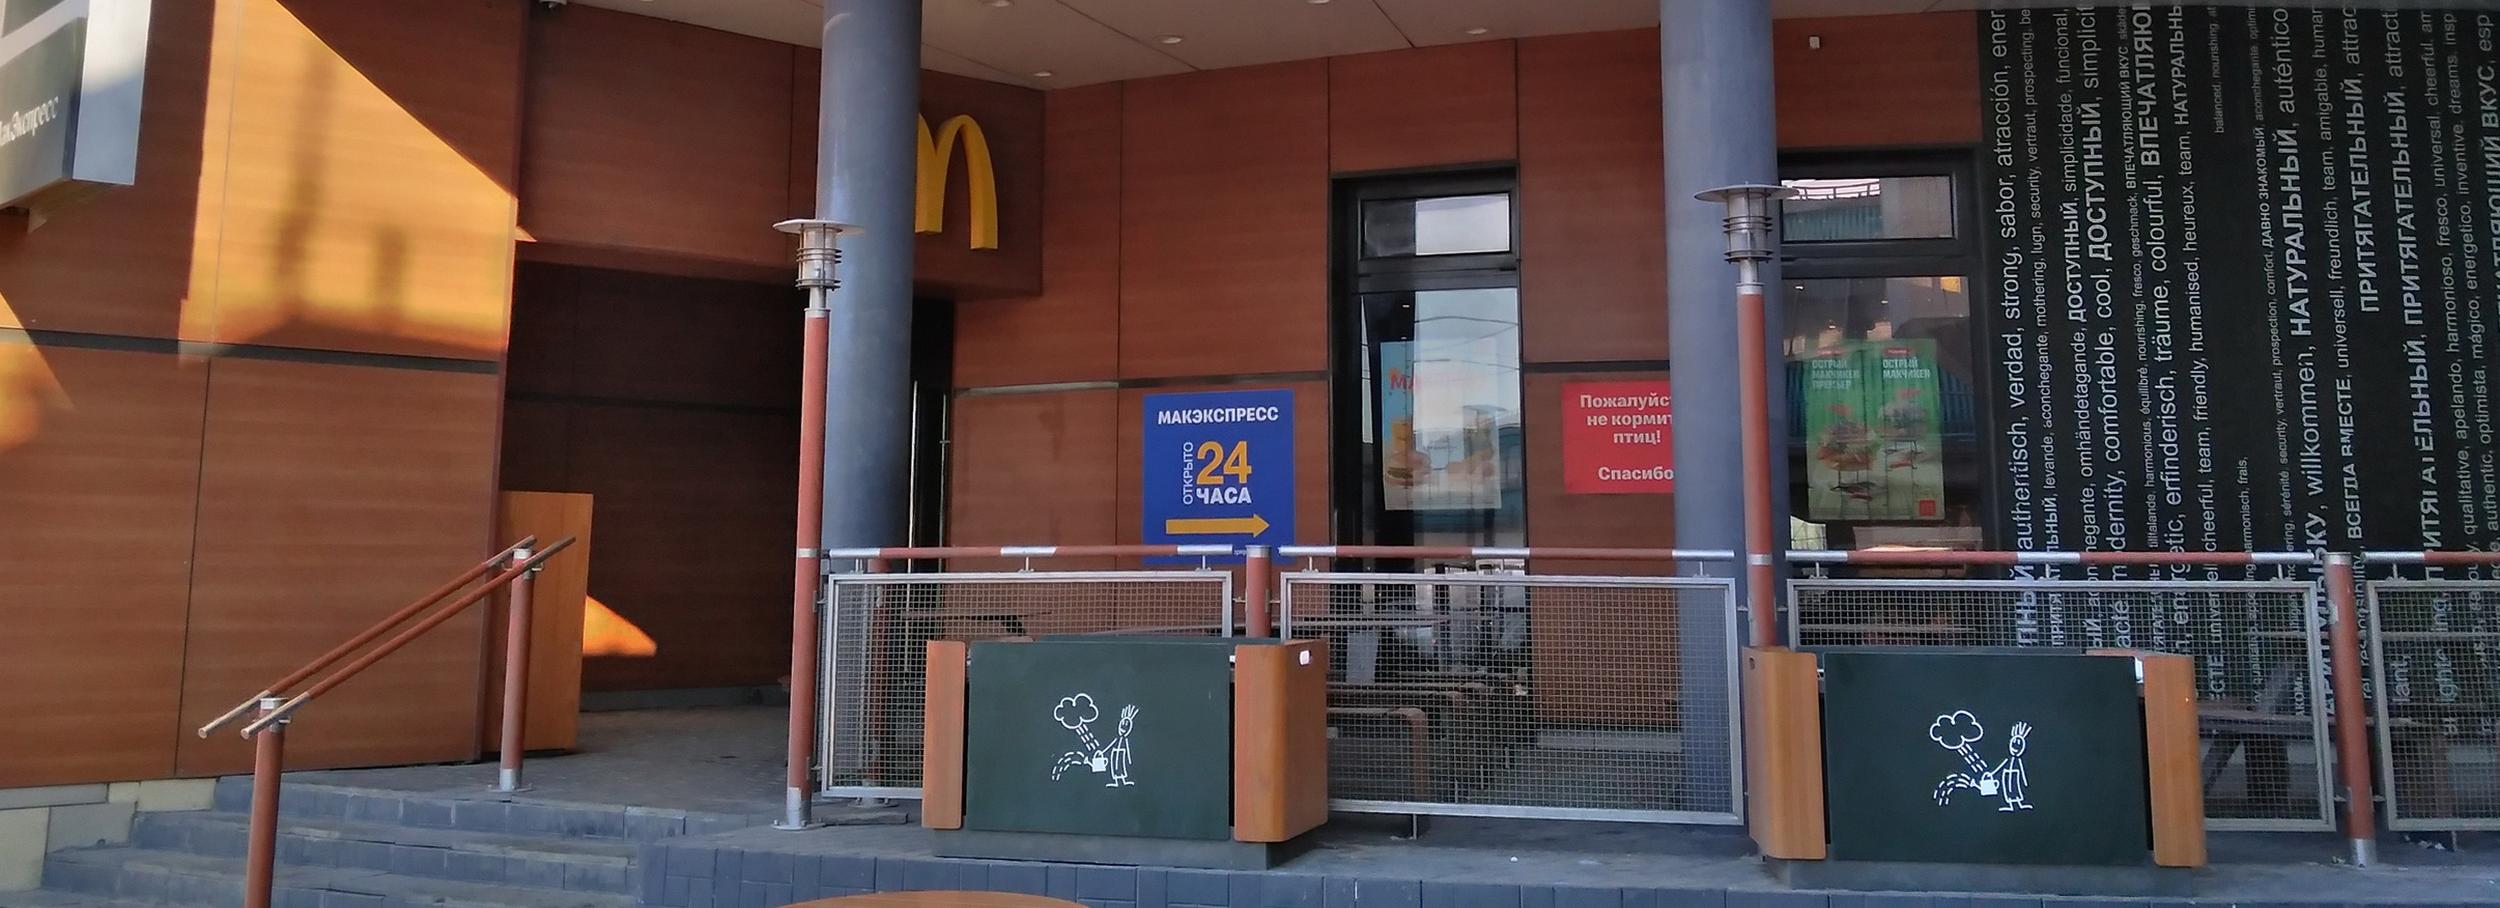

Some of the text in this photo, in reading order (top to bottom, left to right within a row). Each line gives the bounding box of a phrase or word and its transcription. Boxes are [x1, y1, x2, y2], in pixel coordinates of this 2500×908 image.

[2052, 8, 2073, 84] funcional,
[2270, 8, 2296, 114] auténtico
[2476, 15, 2494, 52] esp
[2131, 5, 2161, 165] ВПЕЧАТЛЯЮ
[2212, 81, 2225, 133] balanced,
[2313, 64, 2334, 142] amigable,
[2419, 38, 2440, 106] cheerful,
[2476, 60, 2500, 128] ВКУС,
[1989, 65, 2014, 167] atracción,
[2024, 109, 2039, 162] vertraut,
[2057, 88, 2080, 193] simplicidade,
[2118, 81, 2137, 189] ВПЕЧАТЛЯЮЩИЙ
[2426, 111, 2446, 187] universal,
[2076, 97, 2113, 261] ДОСТУПНЫЙ,
[2177, 131, 2194, 176] team,
[2320, 146, 2337, 191] team,
[2451, 119, 2470, 195] inventive,
[1995, 174, 2018, 239] sabor,
[2027, 166, 2042, 219] security,
[2126, 193, 2142, 257] geschmack,
[2142, 174, 2169, 272] colourful,
[2181, 181, 2198, 252] heureux,
[2259, 203, 2275, 248] ДАВНО
[2339, 73, 2380, 313] ПРИТЯГАТЕЛЬНЫЙ,
[2382, 86, 2423, 325] ПРИТЯГАТЕЛЬНЫЙ,
[2435, 193, 2451, 247] fresco,
[2030, 222, 2046, 254] lugn,
[2059, 197, 2088, 323] ДОСТУПНЫЙ,
[2271, 121, 2312, 336] НАТУРАЛЬНЫЙ,
[2323, 196, 2343, 280] freundlich,
[2458, 200, 2479, 290] energetico,
[2001, 245, 2022, 320] strong,
[2032, 257, 2049, 327] mothering,
[2090, 267, 2113, 318] cool,
[2130, 260, 2143, 297] fresco,
[2184, 257, 2204, 352] humanised,
[2264, 250, 2277, 295] comfort,
[2440, 252, 2460, 353] harmonioso,
[2133, 300, 2147, 361] nourishing,
[2152, 279, 2174, 362] träume,
[2268, 298, 2284, 366] prospection,
[2329, 286, 2350, 369] universell,
[2467, 296, 2486, 359] mágico,
[1882, 356, 1918, 369] ОСТРЫЙ
[2002, 327, 2025, 408] verdad,
[2036, 331, 2054, 428] aconchegante,
[2094, 326, 2121, 462] comfortable,
[2190, 357, 2209, 422] friendly,
[2271, 369, 2286, 415] vertraut,
[1158, 406, 1279, 425] МАКЭКСПРЕСС
[1579, 392, 1673, 411] Пожалуйс
[1587, 415, 1608, 427] не
[2070, 328, 2094, 478] omhändetagande,
[2297, 346, 2324, 496] willkommen,
[2335, 374, 2355, 457] ВМЕСТЕ,
[2448, 358, 2470, 440] apelando,
[2472, 365, 2494, 445] optimista,
[1196, 440, 1253, 485] 24
[1613, 429, 1662, 445] птиц!
[2040, 432, 2057, 489] levande,
[2140, 418, 2156, 487] harmonious,
[2155, 370, 2183, 505] erfinderisch,
[2196, 426, 2212, 474] team,
[2236, 457, 2249, 484] frais,
[2275, 418, 2290, 464] security,
[1182, 441, 1194, 505] ОТКРЫТО
[1196, 486, 1252, 504] ЧАСА
[1598, 465, 1674, 481] Спасибо
[2007, 416, 2034, 550] authentisch,
[2342, 464, 2363, 539] ВСЕГДА
[2456, 446, 2478, 535] qualitative,
[2480, 450, 2499, 531] authentic,
[2103, 470, 2129, 582] mdernity,
[2198, 479, 2218, 551] cheerful,
